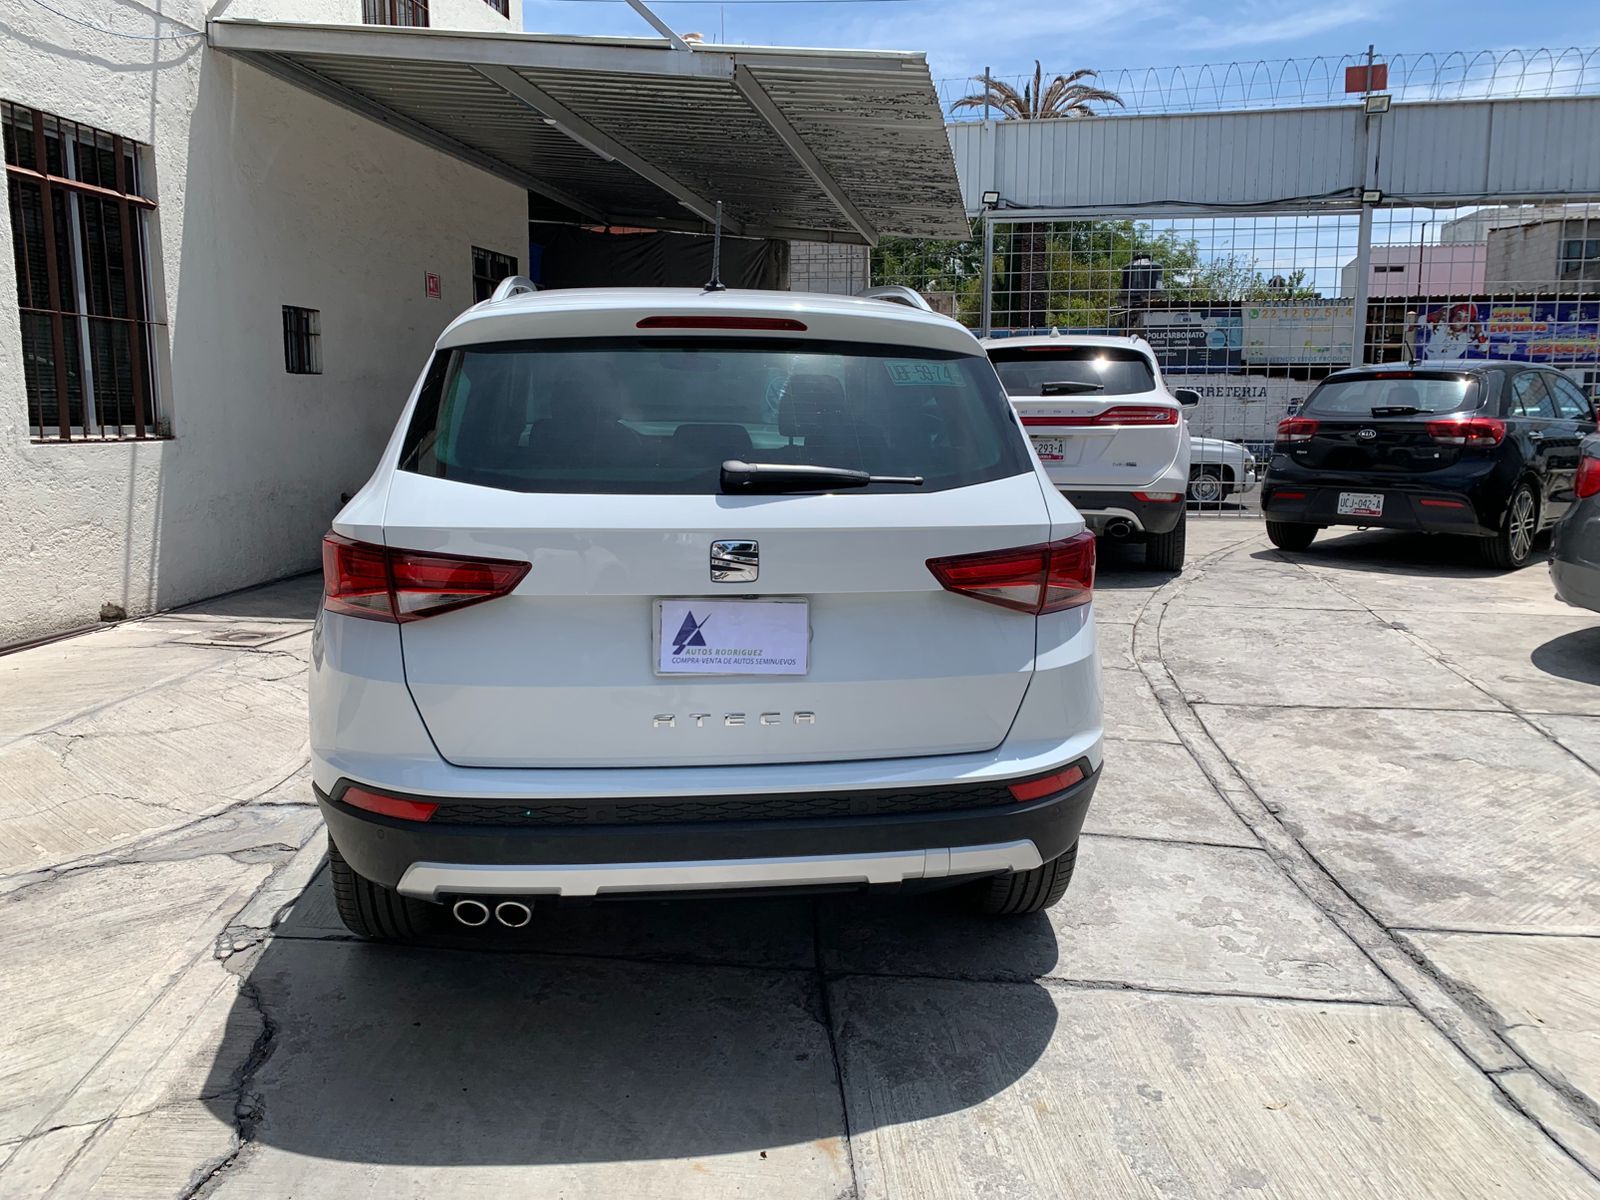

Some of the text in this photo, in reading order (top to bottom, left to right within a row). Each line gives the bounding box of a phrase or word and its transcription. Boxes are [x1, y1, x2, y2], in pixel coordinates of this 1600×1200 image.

[1177, 386, 1267, 397] RRETERIA
[1340, 498, 1381, 509] UCJ-042-A
[685, 648, 763, 656] AUTOS RODRIGUEZ
[755, 658, 797, 666] SEMINUEVOS
[653, 711, 816, 728] ATECA
